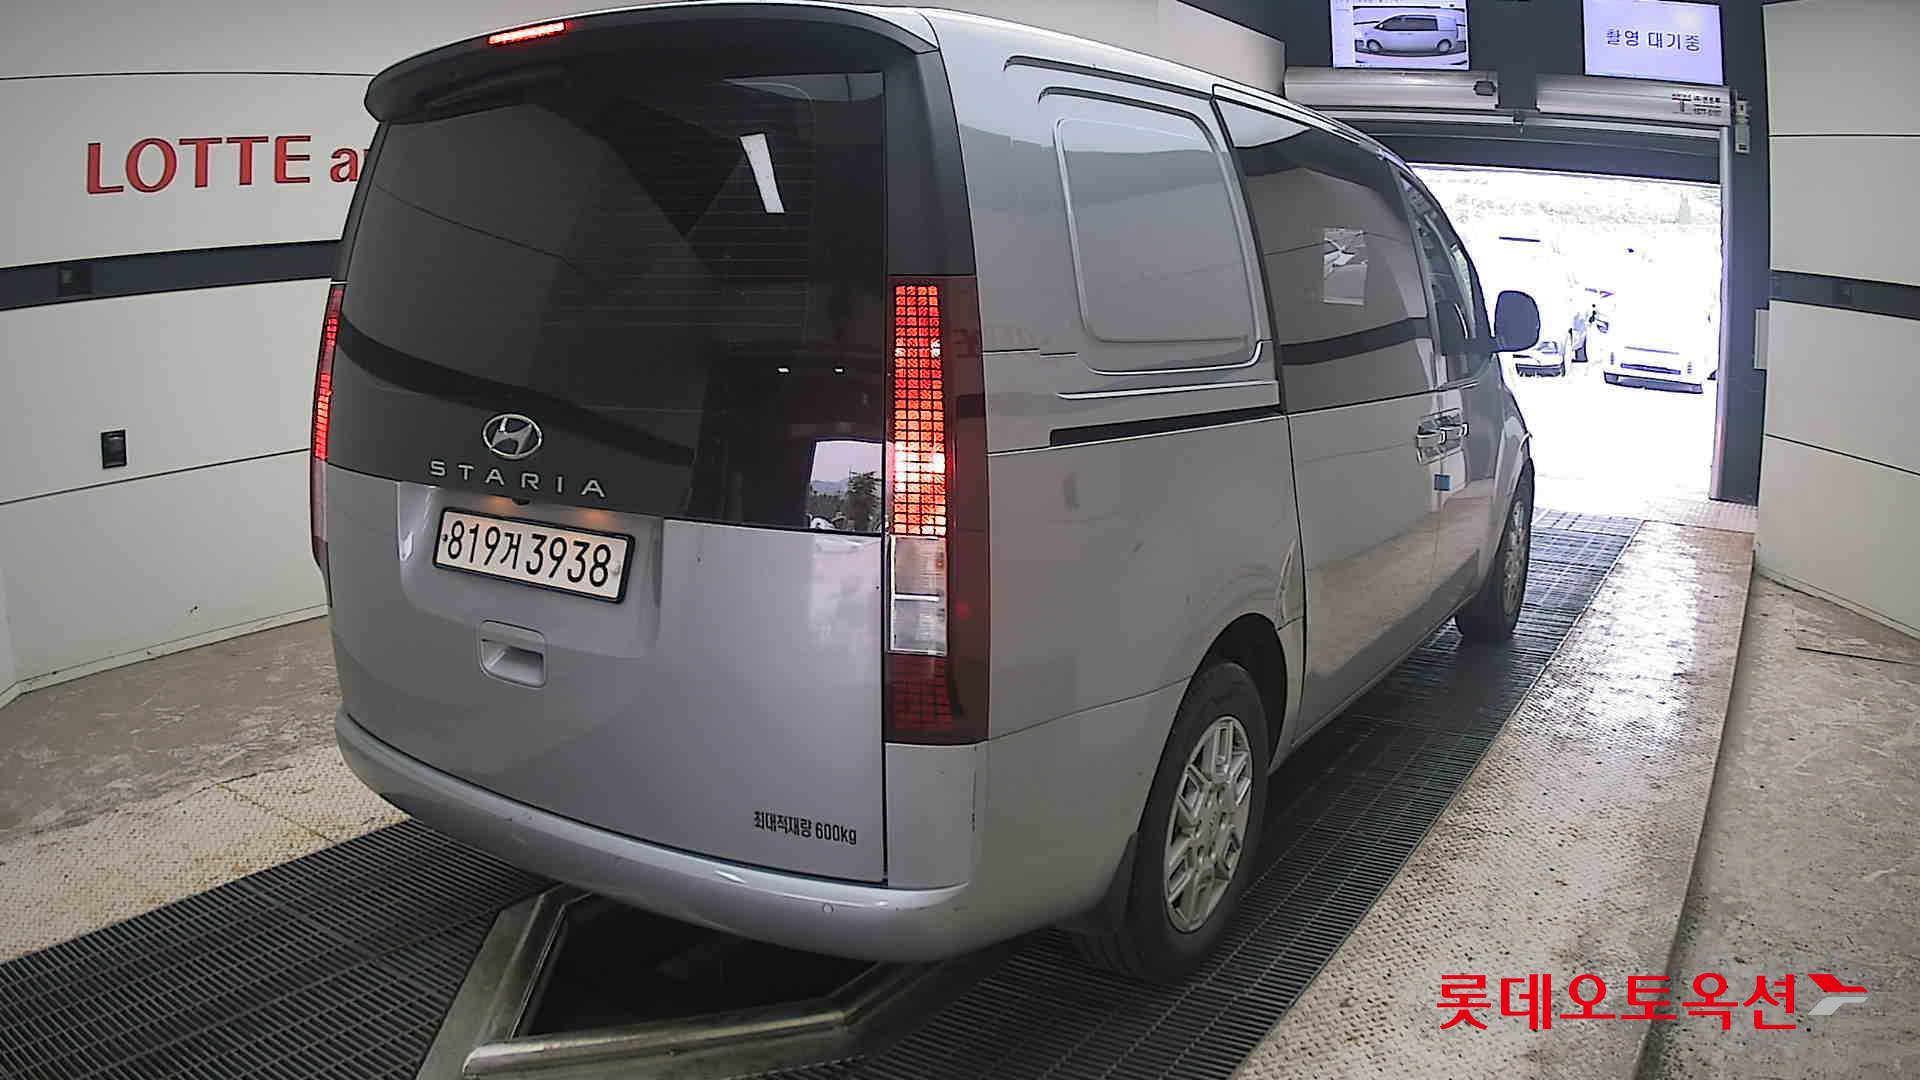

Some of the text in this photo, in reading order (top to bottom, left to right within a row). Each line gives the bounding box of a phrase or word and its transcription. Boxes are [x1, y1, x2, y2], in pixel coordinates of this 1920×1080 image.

[1606, 28, 1640, 47] 촬영
[87, 135, 312, 194] LOTTE
[429, 460, 606, 498] STARIA
[753, 810, 857, 846] 최대적재량 600kg
